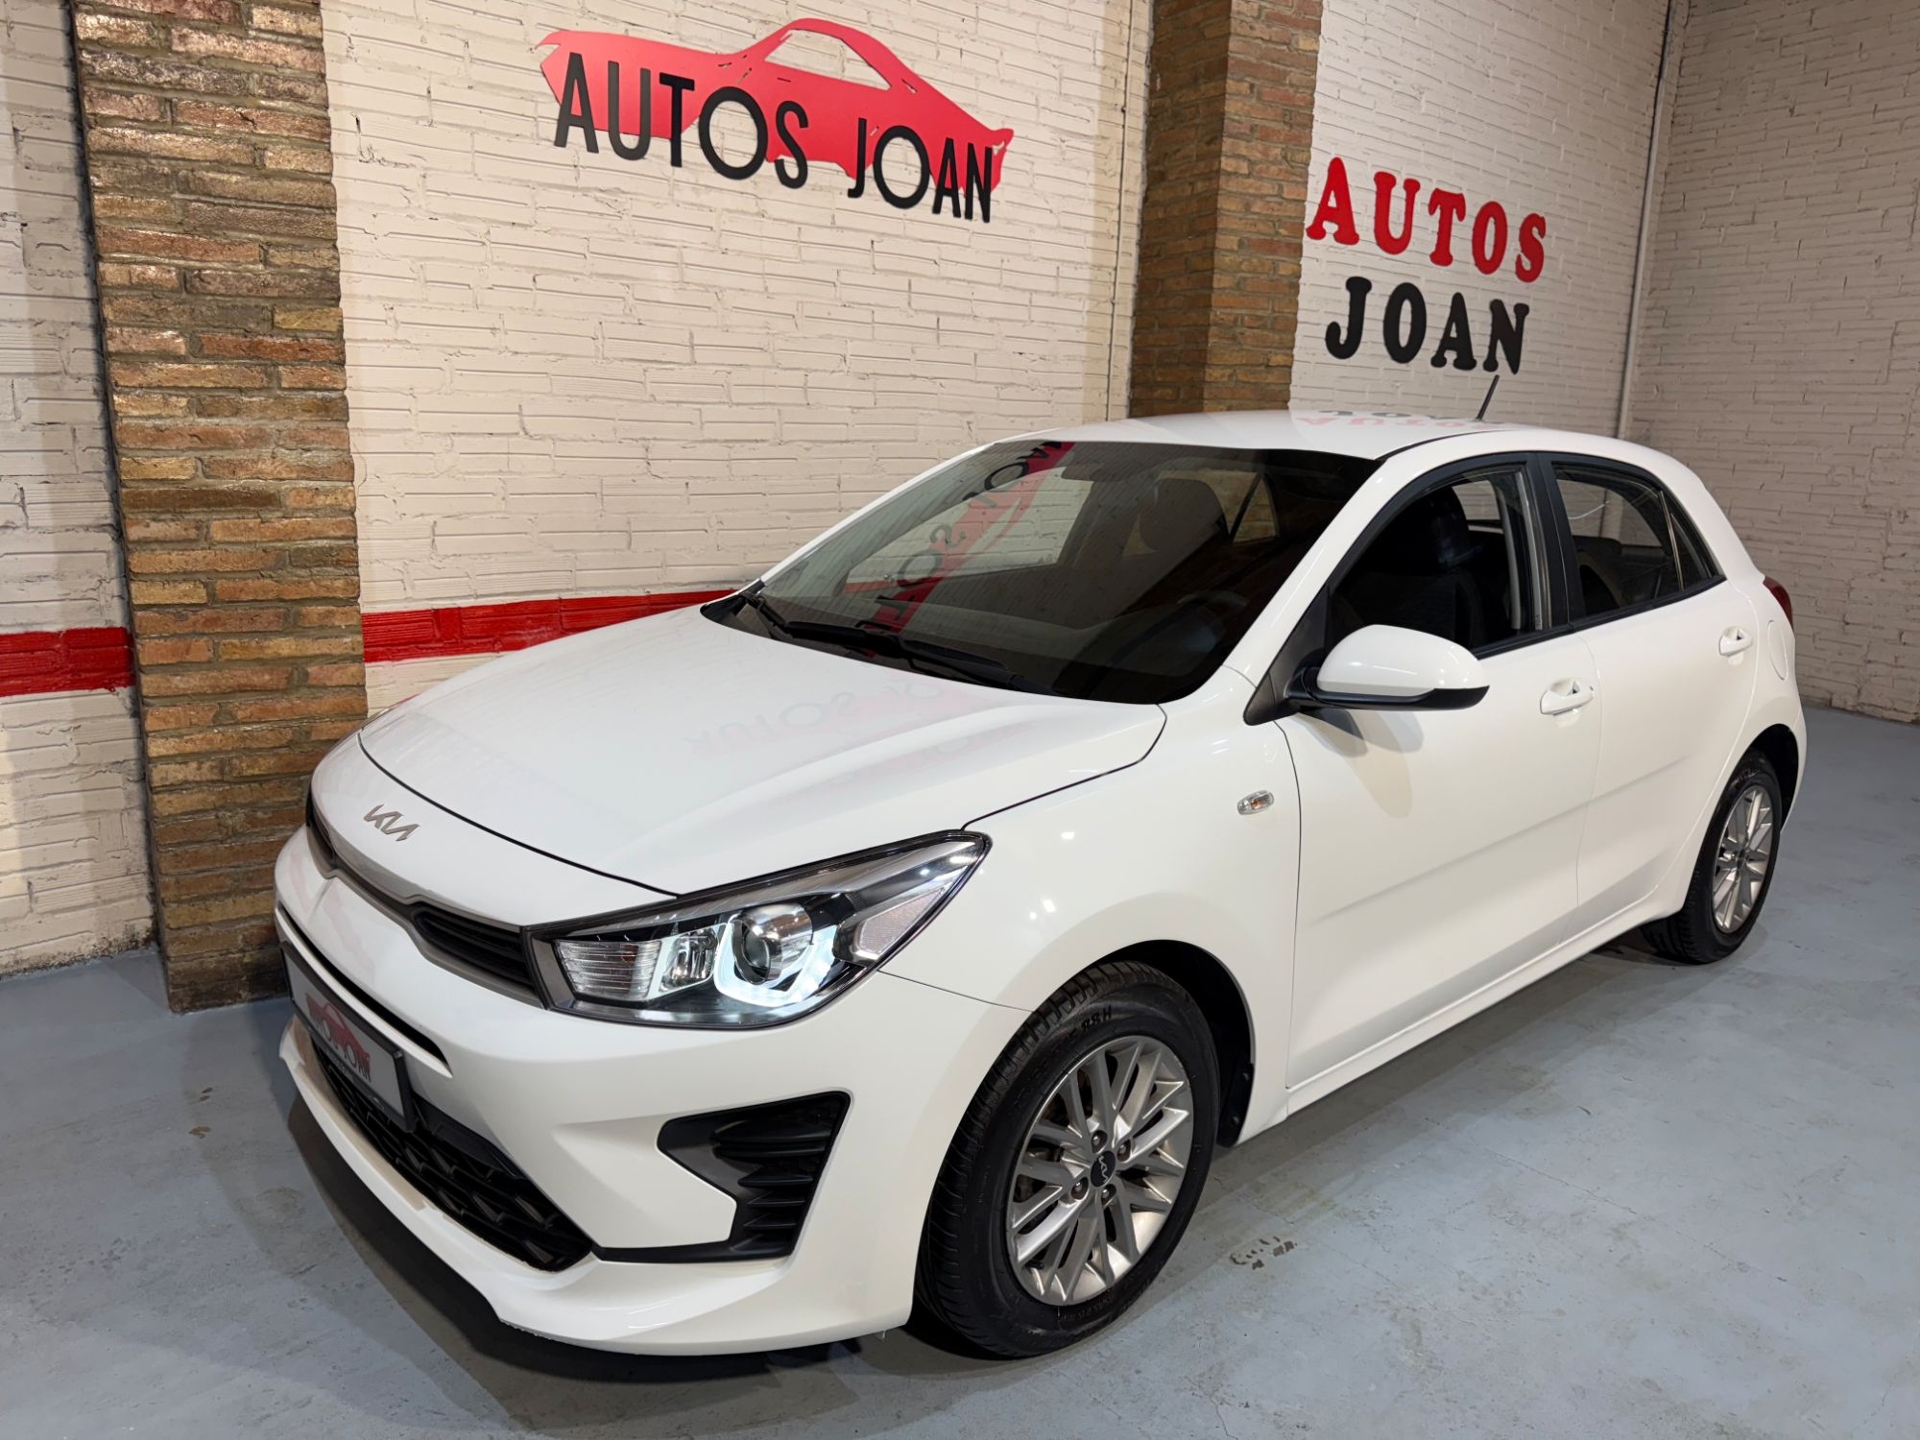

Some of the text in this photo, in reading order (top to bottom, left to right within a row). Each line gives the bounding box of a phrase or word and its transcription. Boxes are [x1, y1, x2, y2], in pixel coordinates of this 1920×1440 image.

[554, 51, 992, 222] AUTOS JOAN
[1306, 157, 1546, 283] AUTOS
[1325, 276, 1530, 374] JOAN
[363, 804, 419, 841] KIA
